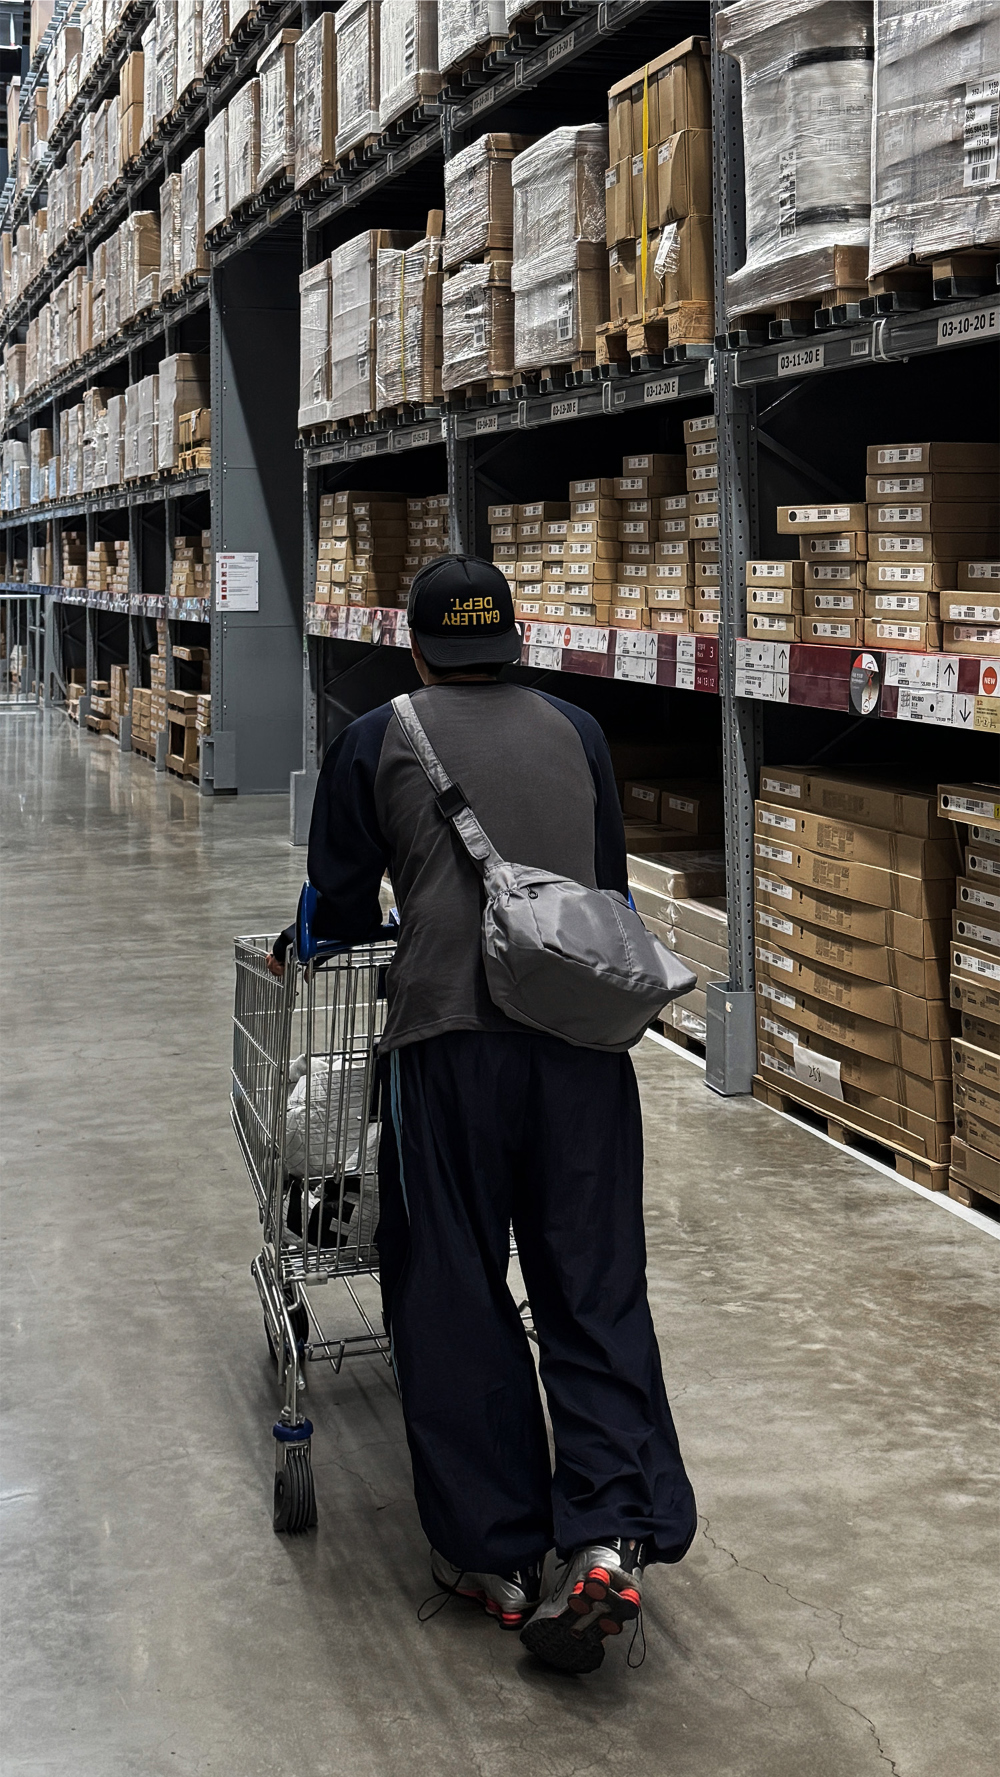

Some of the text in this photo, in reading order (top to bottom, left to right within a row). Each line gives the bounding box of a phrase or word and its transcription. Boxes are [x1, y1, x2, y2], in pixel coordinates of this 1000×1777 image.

[941, 312, 995, 338] 03-10-20 E
[780, 348, 820, 369] 03-11-20 E
[646, 383, 676, 399] 03-12-20 E
[572, 401, 576, 412] E
[450, 596, 493, 610] DEPT.
[442, 610, 501, 626] GALLERY
[709, 646, 714, 658] 3
[984, 676, 996, 685] NEW
